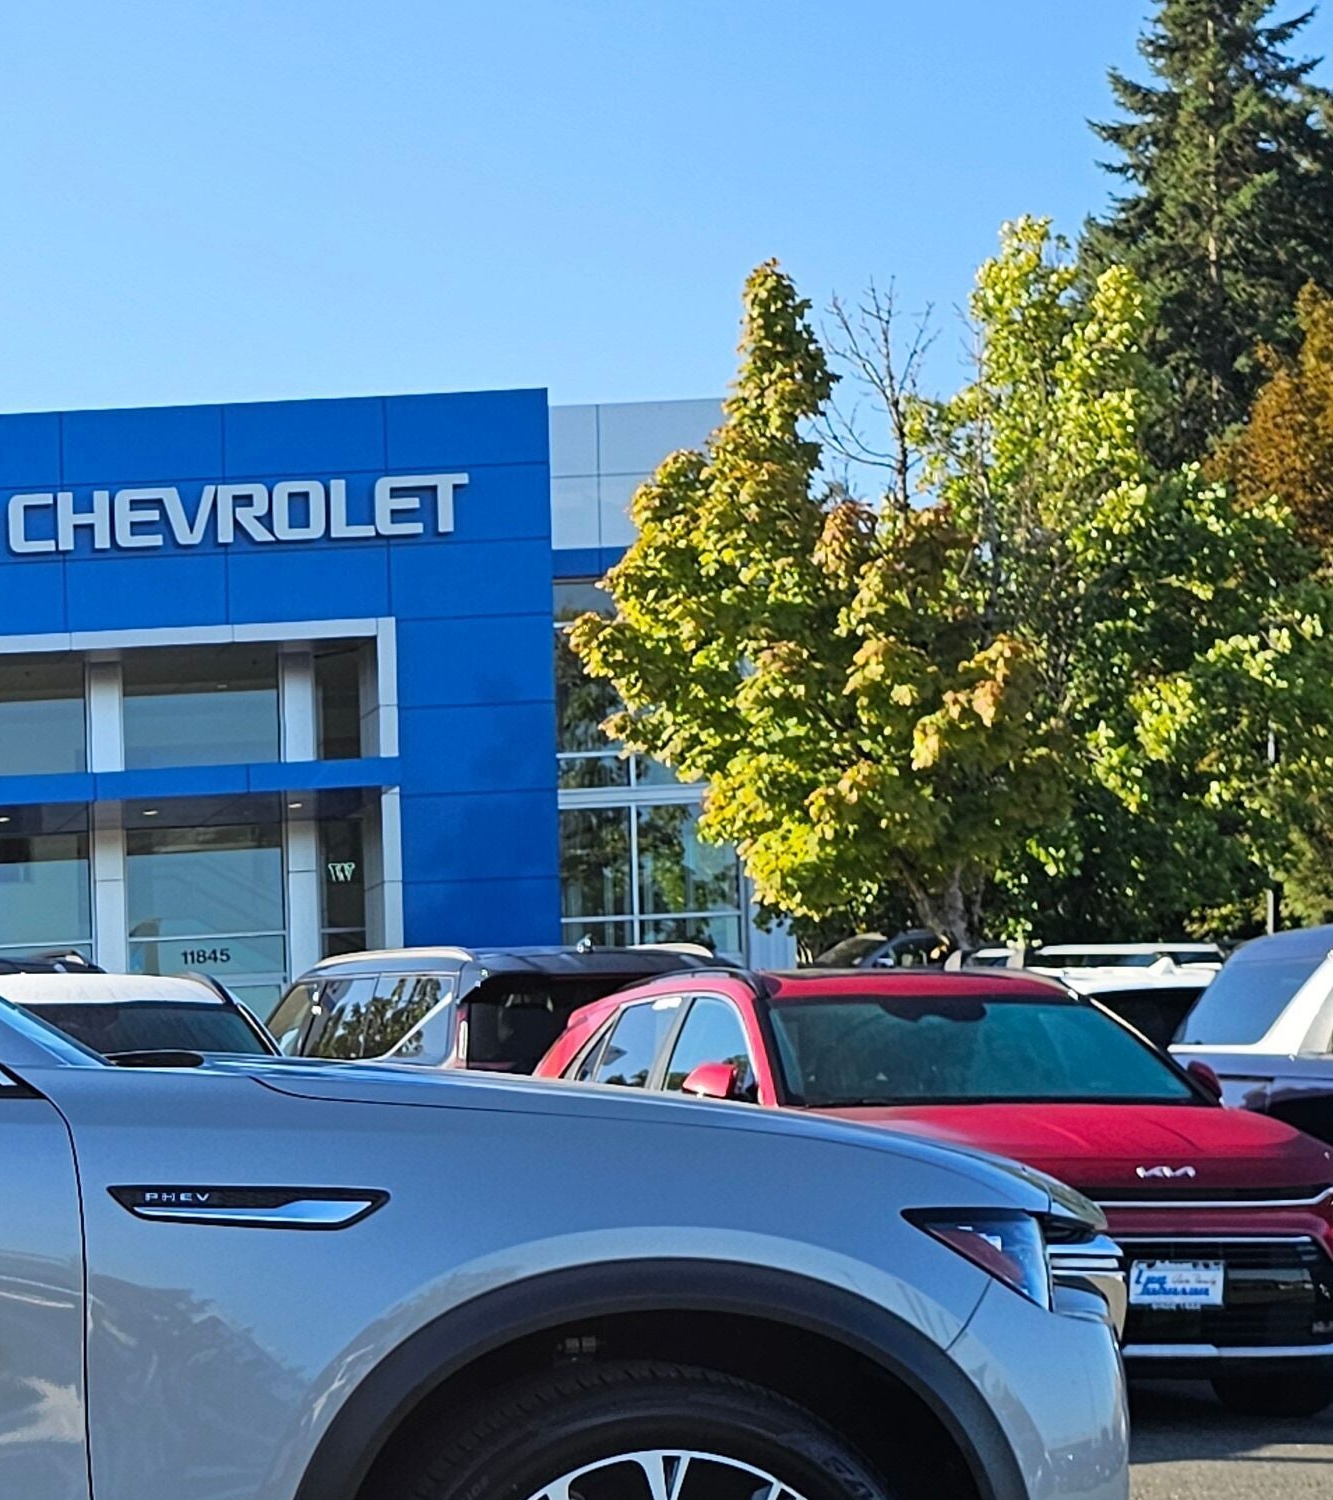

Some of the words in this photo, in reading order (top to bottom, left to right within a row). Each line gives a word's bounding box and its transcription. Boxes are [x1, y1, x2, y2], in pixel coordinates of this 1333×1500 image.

[8, 473, 469, 553] CHEVROLET
[181, 948, 231, 965] 11845
[145, 1192, 210, 1202] PHEV
